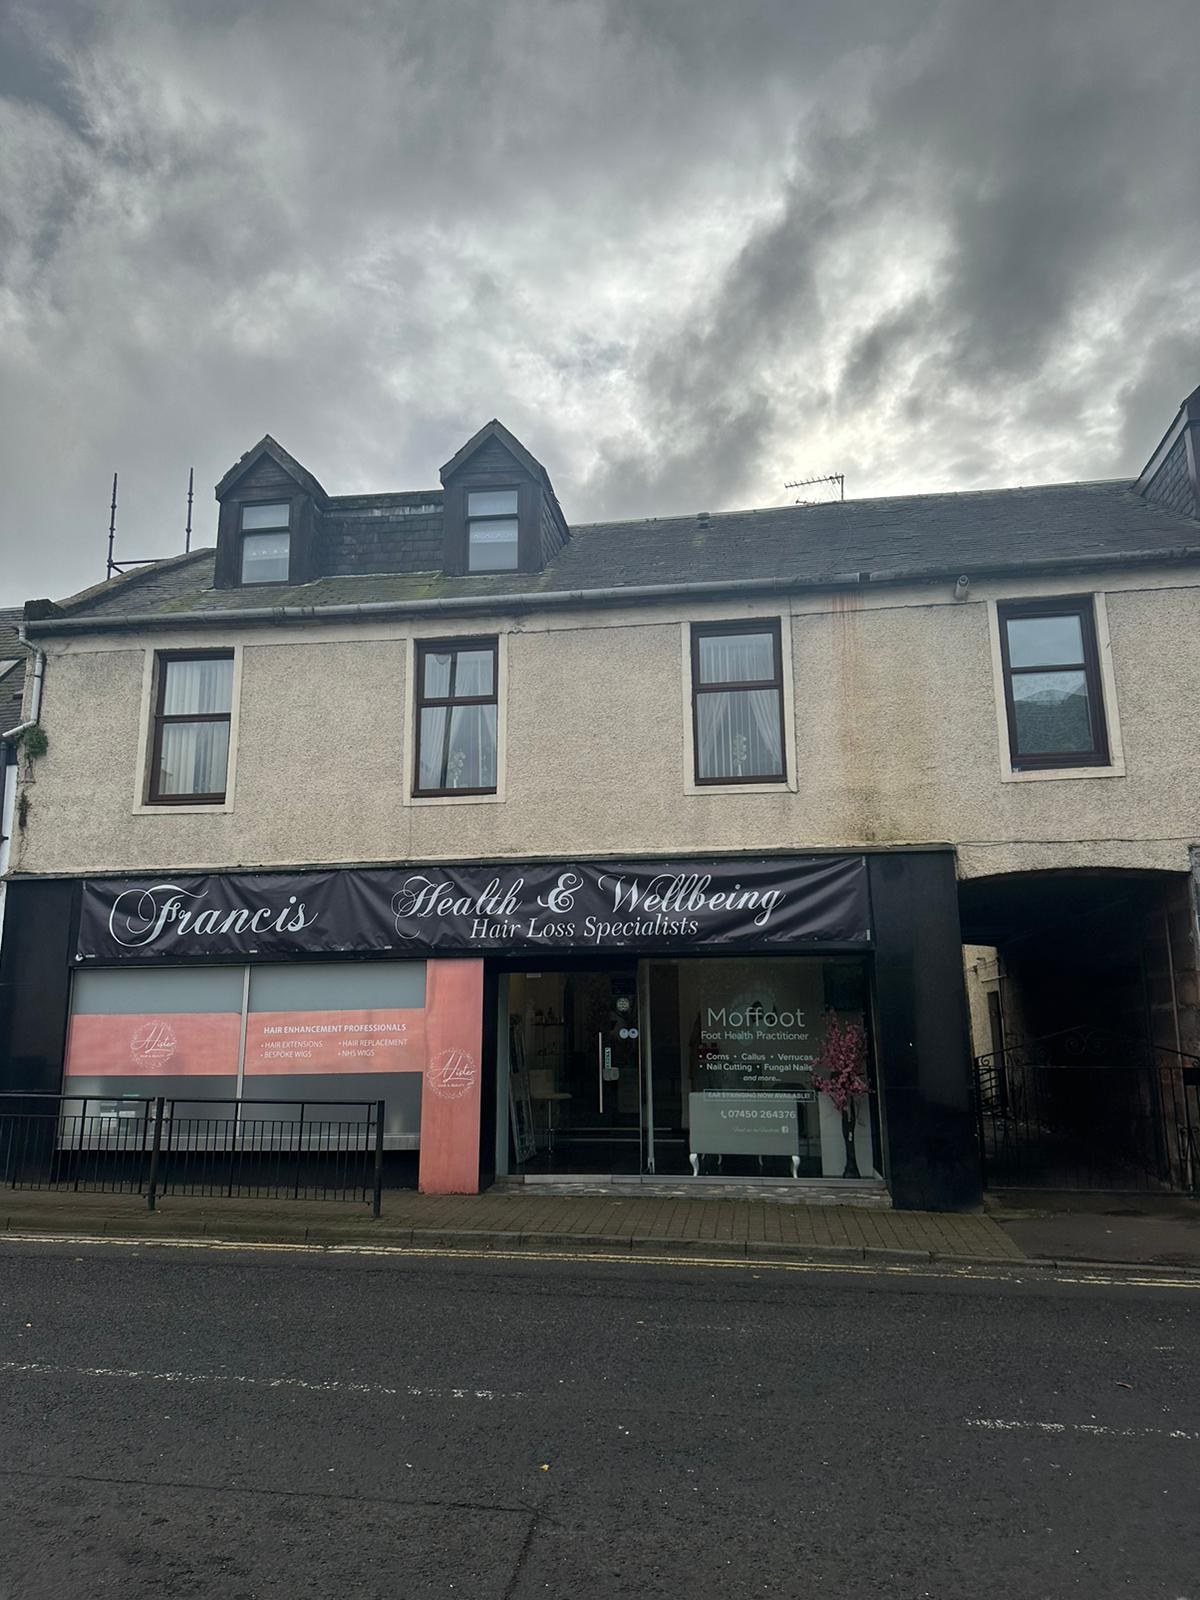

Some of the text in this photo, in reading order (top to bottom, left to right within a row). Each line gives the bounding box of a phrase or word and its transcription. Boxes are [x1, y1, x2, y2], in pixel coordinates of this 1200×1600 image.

[391, 872, 786, 939] Health & Wellbeing
[109, 884, 318, 947] Francis
[470, 913, 699, 944] Hair Loss Specialists
[707, 1006, 806, 1028] Moffoot
[263, 1023, 407, 1034] HAIR ENHANCEMENT PROFESSIONALS
[701, 1031, 810, 1041] Foot Health Practitioner
[264, 1040, 323, 1049] HAIR EXTENSIONS
[342, 1038, 408, 1047] HAIR REPLACEMENT
[264, 1050, 312, 1059] BESPOKE WIGS
[342, 1049, 375, 1057] NHS WIGS
[706, 1053, 814, 1061] Corns Callus Verrucas
[706, 1063, 813, 1072] Nail Cutting Fungal Nails
[728, 1110, 797, 1119] 07450 264376
